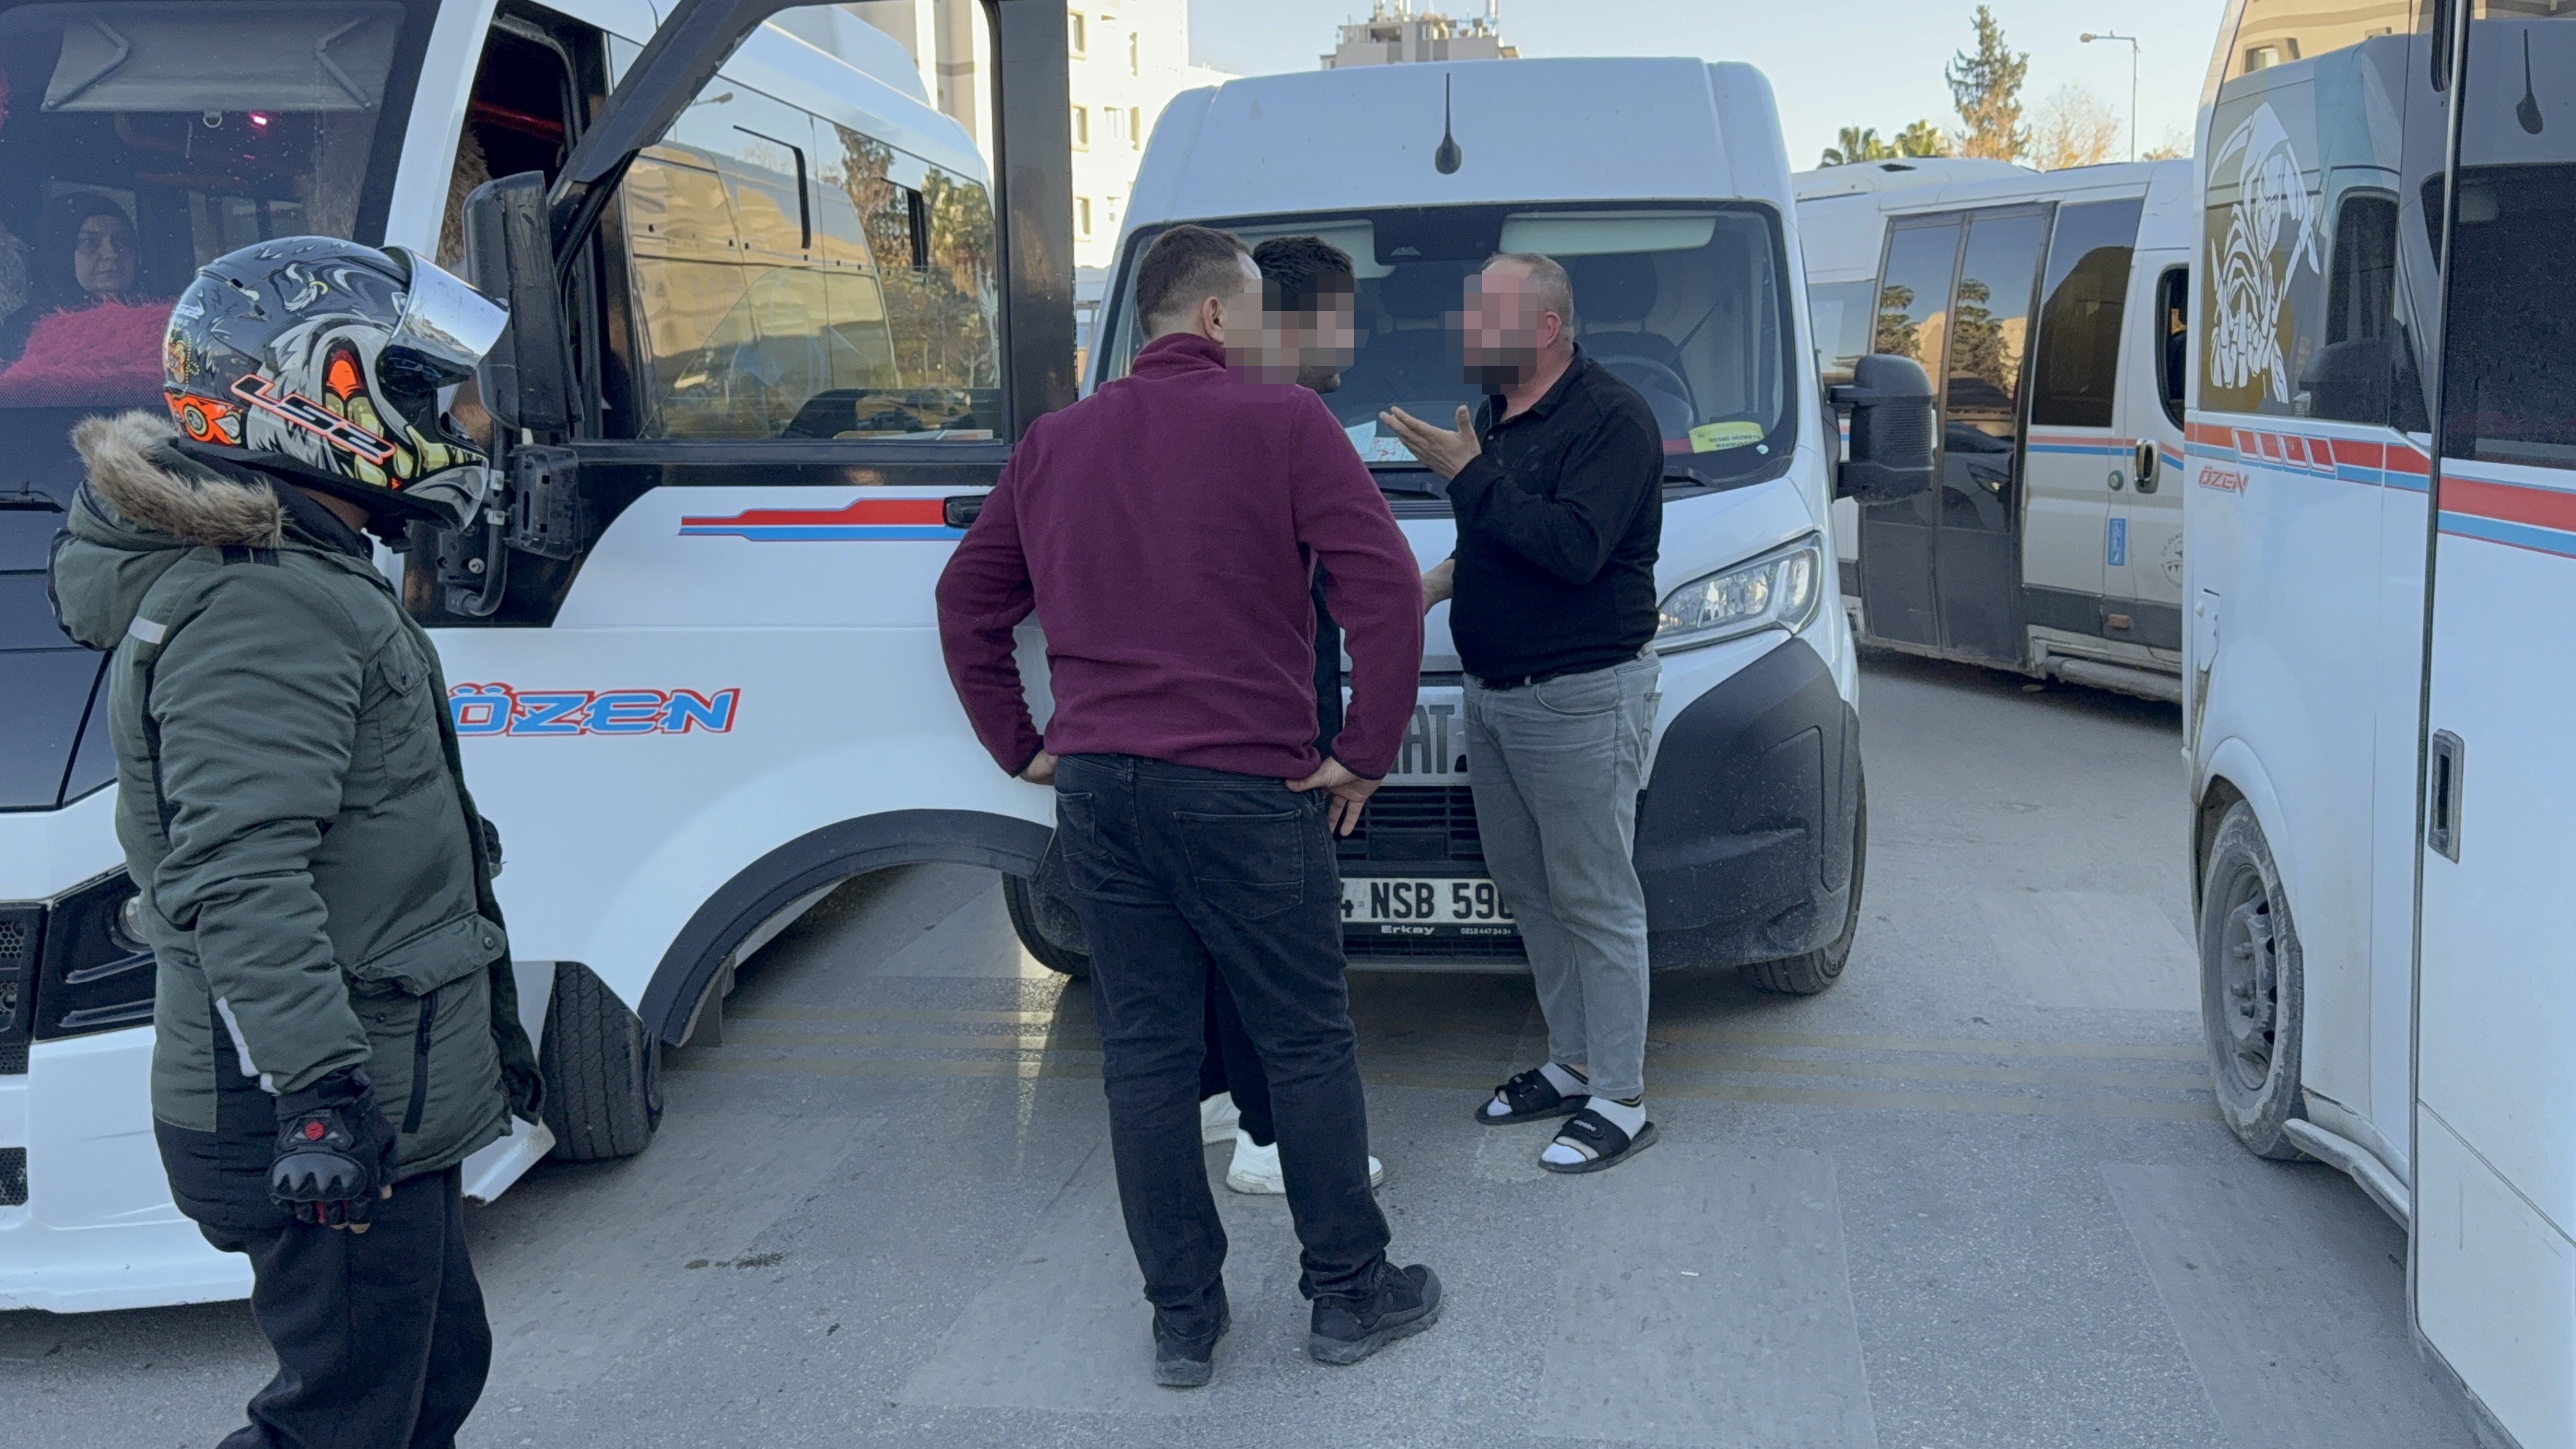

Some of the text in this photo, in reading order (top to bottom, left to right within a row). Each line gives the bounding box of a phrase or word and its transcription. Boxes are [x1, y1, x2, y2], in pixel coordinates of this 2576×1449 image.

[231, 374, 397, 465] LS2
[2198, 465, 2250, 498] ÖZEN
[449, 682, 741, 737] ÖZEN
[1389, 704, 1455, 774] AT
[1371, 882, 1434, 918] NSB
[1381, 925, 1435, 935] Erkay
